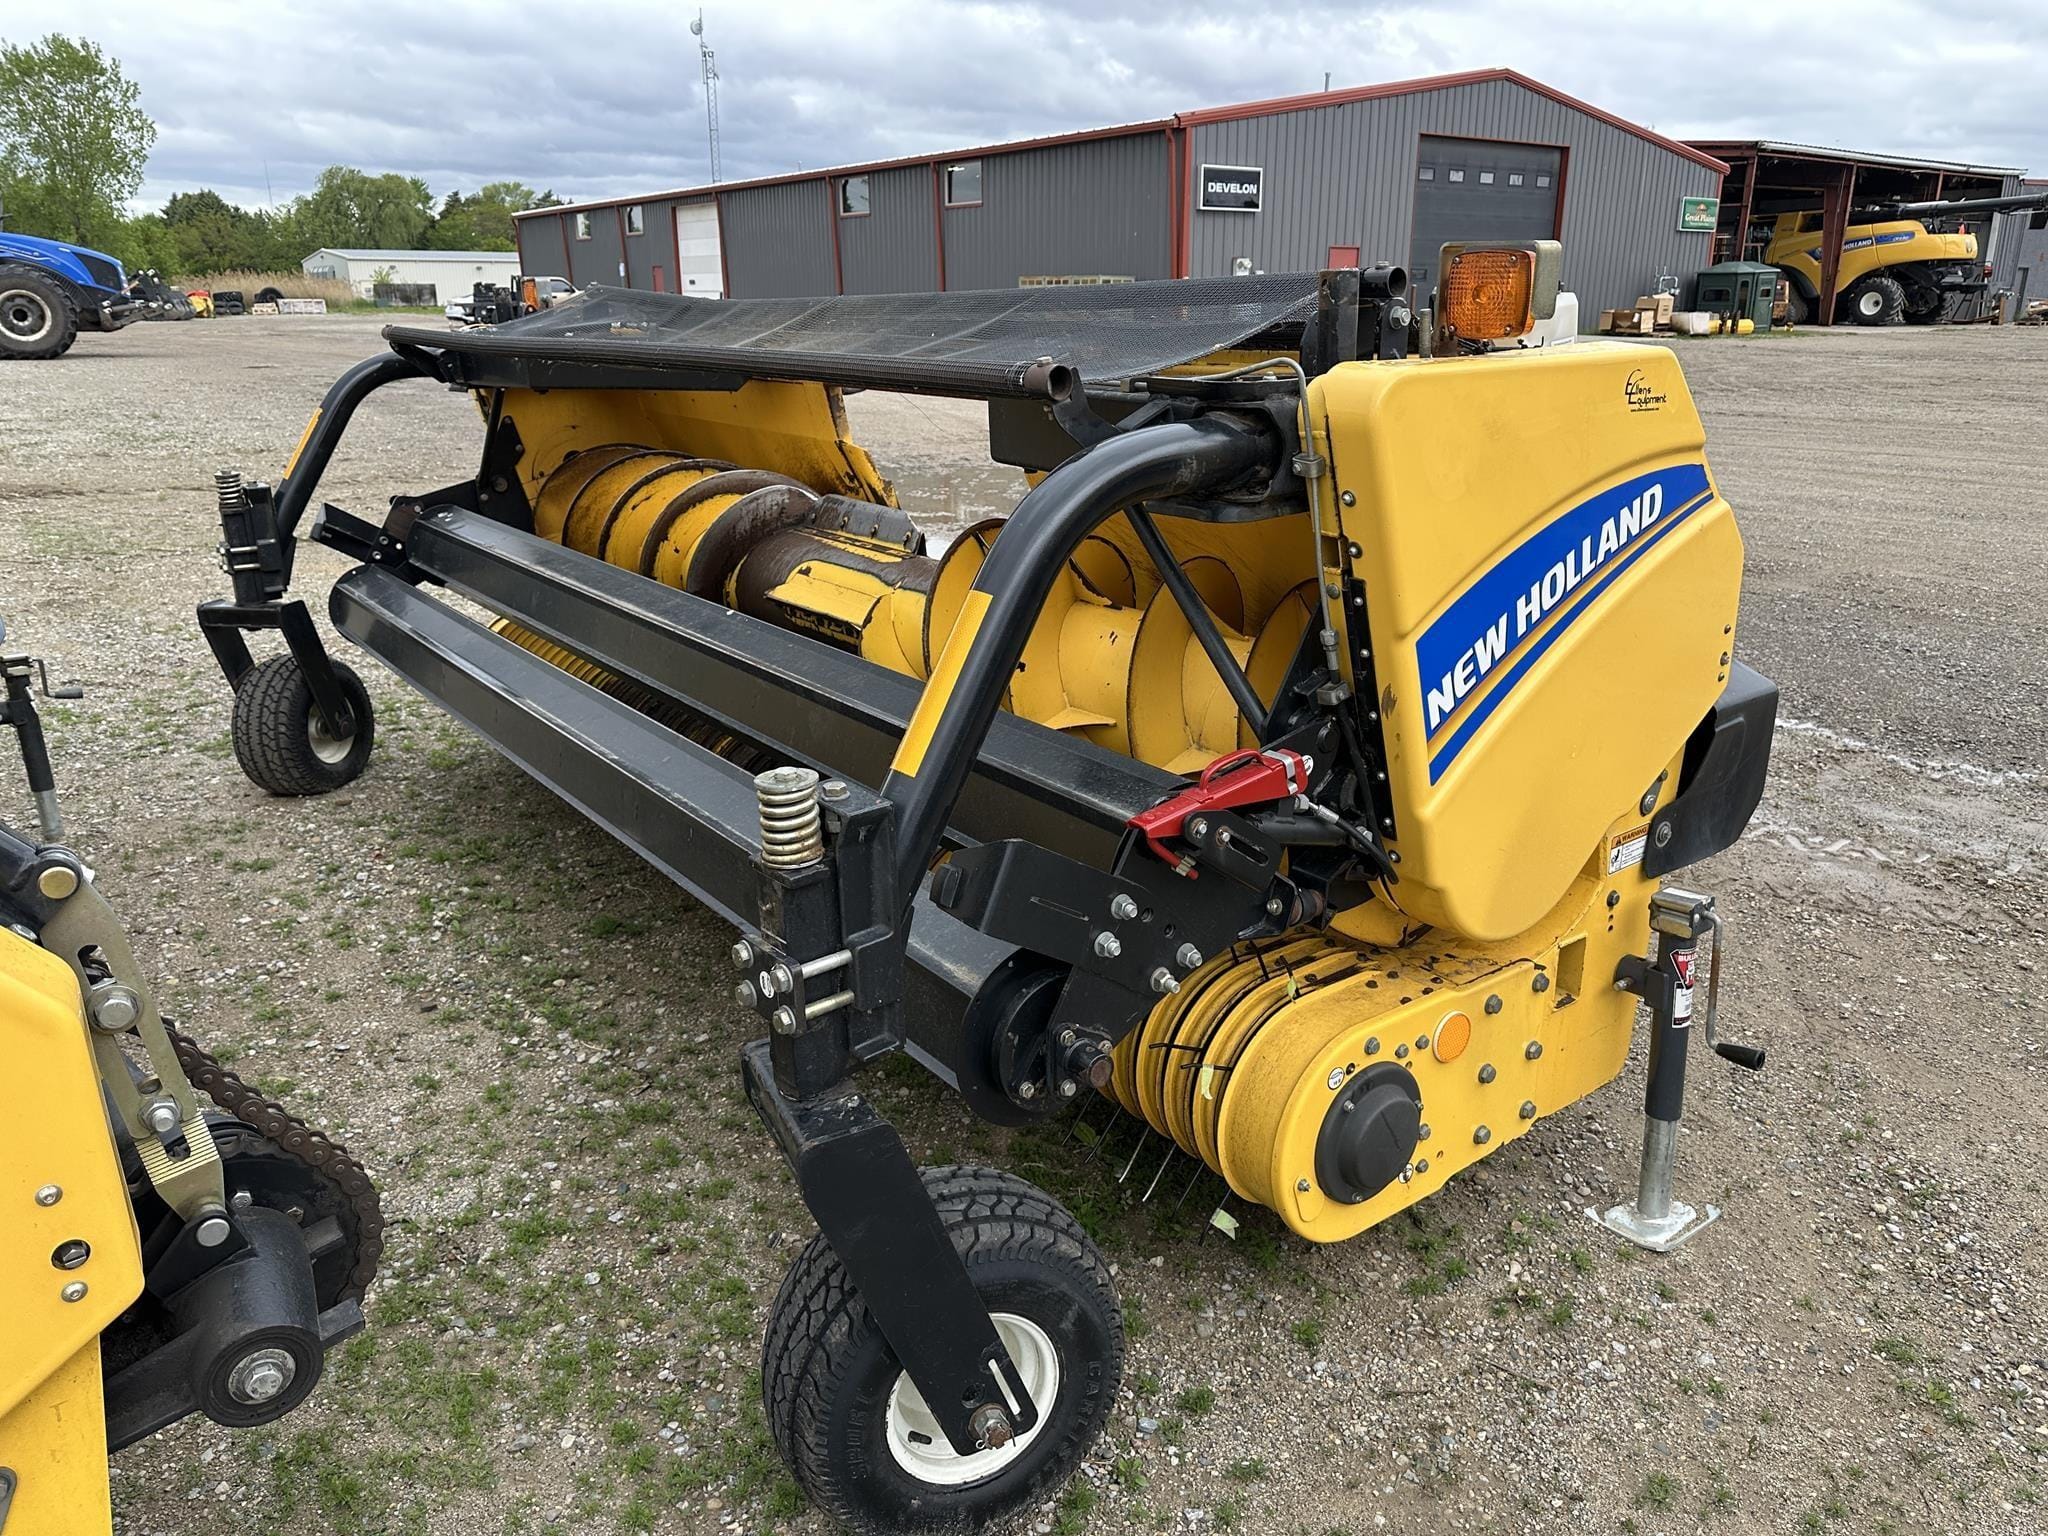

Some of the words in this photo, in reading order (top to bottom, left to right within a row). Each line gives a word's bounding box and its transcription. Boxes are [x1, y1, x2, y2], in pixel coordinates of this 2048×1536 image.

[1207, 181, 1258, 194] DEVELON
[1427, 612, 1508, 731] NEW
[1516, 483, 1663, 638] HOLLAND
[1621, 826, 1648, 842] WARNING
